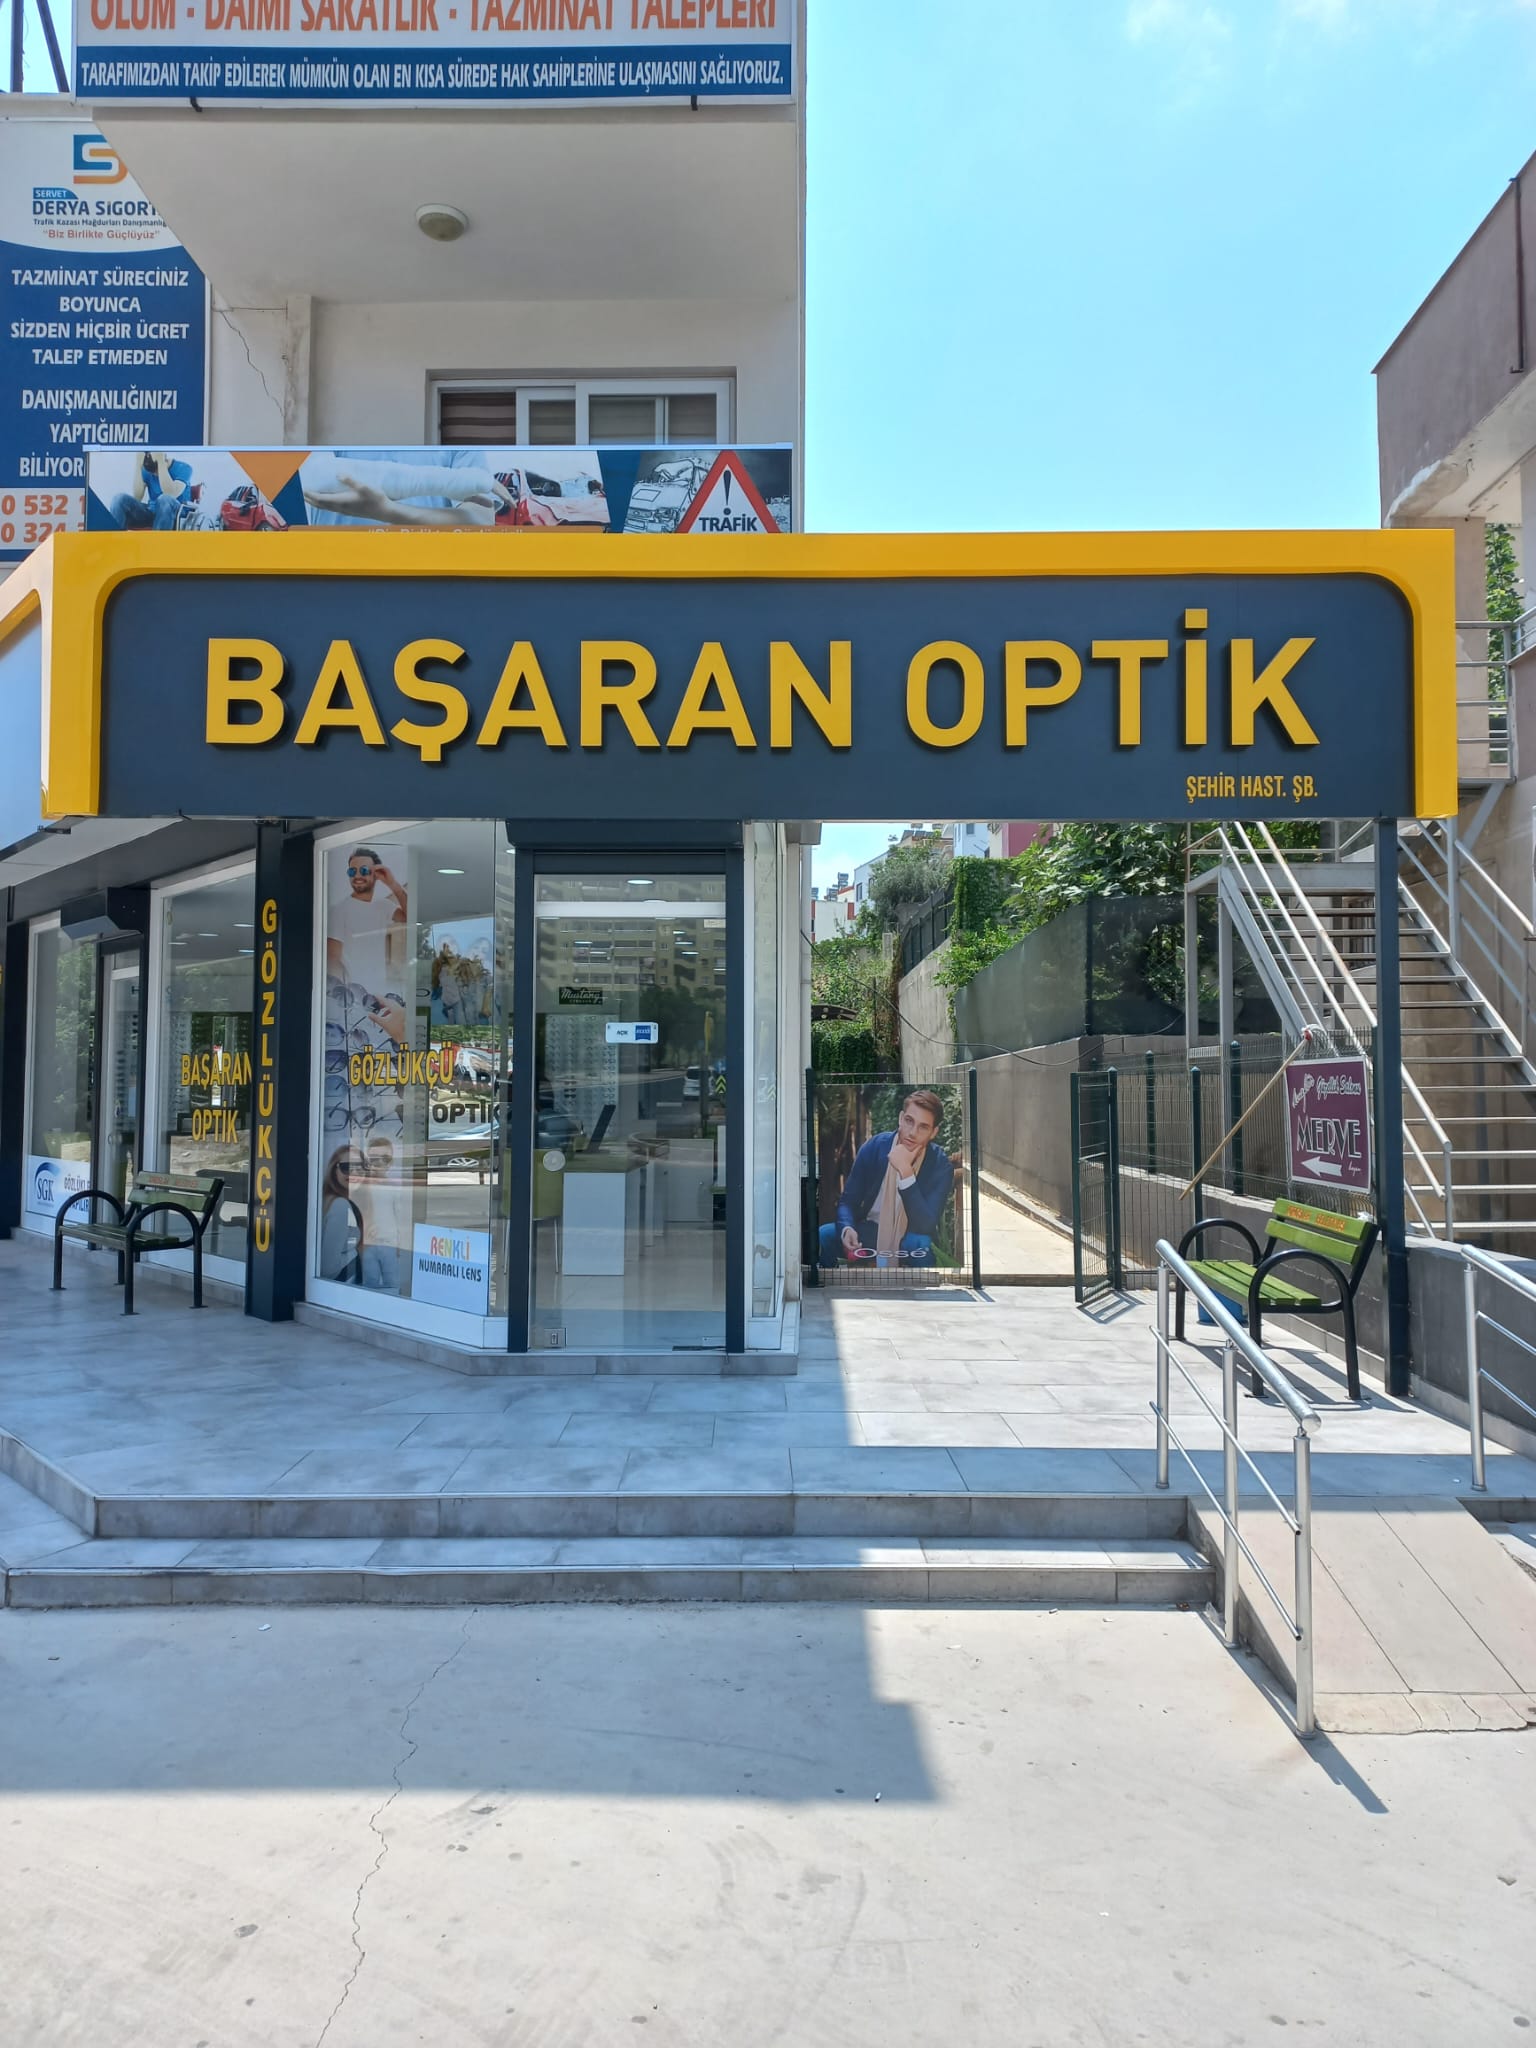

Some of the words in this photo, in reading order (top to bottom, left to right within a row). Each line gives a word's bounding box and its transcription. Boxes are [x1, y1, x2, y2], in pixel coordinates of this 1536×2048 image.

[81, 63, 179, 86] TARAFIMIZDAN
[183, 56, 221, 87] TAKİP
[225, 56, 286, 88] EDİLEREK
[290, 57, 349, 88] MÜMKÜN
[353, 64, 390, 88] OLAN
[394, 64, 411, 88] EN
[416, 64, 445, 88] KISA
[448, 57, 497, 88] SÜREDE
[501, 64, 529, 88] HAK
[532, 56, 615, 87] SAHİPLERİNE
[619, 61, 697, 93] ULAŞMASINI
[700, 53, 783, 86] SAĞLIYORUZ.
[35, 190, 68, 198] SERVET
[32, 201, 90, 216] DERYA
[95, 200, 160, 216] SİGORT
[34, 218, 55, 226] Trafik
[67, 229, 103, 239] Birlikte
[12, 266, 98, 286] TAZMİNAT
[104, 266, 189, 287] SÜRECİNİZ
[60, 297, 141, 313] BOYUNCA
[11, 318, 70, 338] SİZDEN
[76, 319, 132, 343] HİÇBİR
[136, 319, 189, 339] ÜCRET
[32, 349, 83, 364] TALEP
[88, 350, 167, 365] ETMEDEN
[22, 384, 177, 415] DANIŞMANLIĞINIZI
[50, 418, 149, 443] YAPTIĞIMIZI
[19, 452, 85, 477] BİLİYOR
[1, 495, 15, 515] 0
[24, 495, 68, 515] 532
[1, 522, 15, 543] 0
[699, 514, 758, 531] TRAFİK
[205, 637, 852, 762] BAŞARAN
[906, 608, 1321, 748] OPTİK
[1186, 771, 1236, 803] ŞEHİR
[1241, 776, 1286, 798] HAST.
[1292, 776, 1318, 803] ŞB.
[181, 1052, 253, 1087] BAŞARAN
[255, 898, 278, 1252] GÖZLÜKÇÜ
[350, 1041, 454, 1088] GÖZLÜKÇÜ
[192, 1100, 238, 1144] OPTİK
[1297, 1114, 1361, 1160] MERVE
[37, 1178, 54, 1202] SGK
[430, 1236, 470, 1262] RENKLİ
